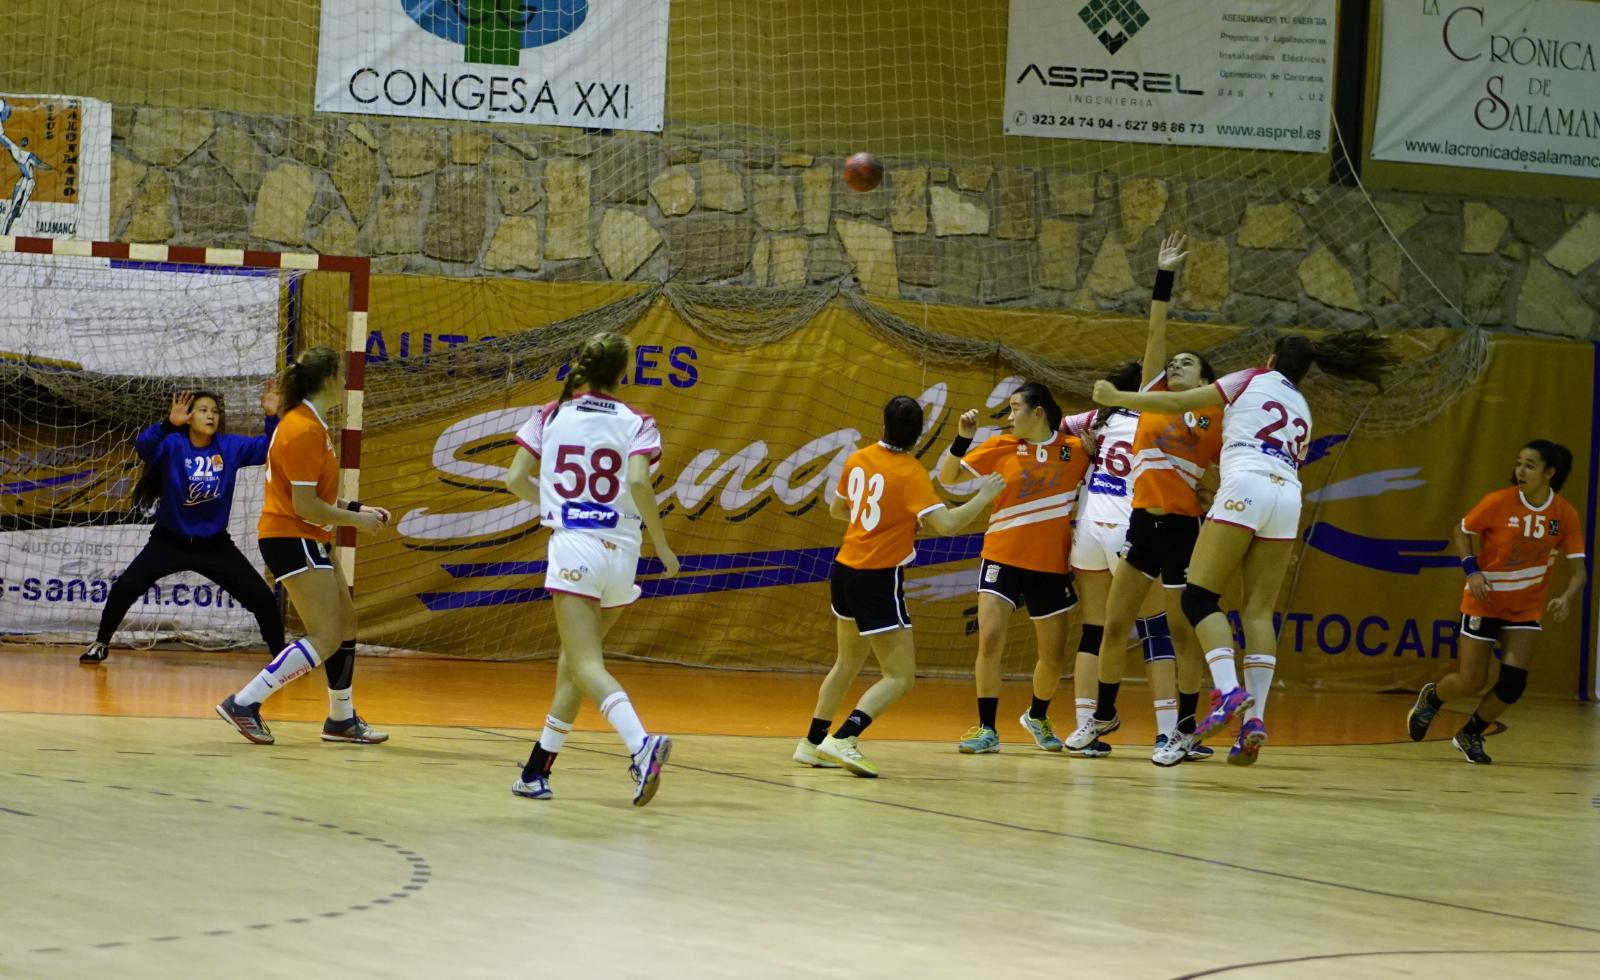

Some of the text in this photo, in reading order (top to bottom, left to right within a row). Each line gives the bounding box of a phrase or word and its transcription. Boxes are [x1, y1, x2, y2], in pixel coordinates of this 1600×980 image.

[1443, 6, 1597, 72] CRÓNICA
[1017, 64, 1204, 95] ASPREL
[1528, 77, 1552, 97] DE
[349, 68, 630, 119] CONGESA XXI
[1032, 114, 1055, 126] 923
[1059, 115, 1075, 126] 24
[1079, 117, 1094, 127] 74
[1098, 118, 1113, 128] 04
[1125, 119, 1148, 131] 627
[1190, 123, 1205, 134] 73
[1217, 123, 1321, 140] www.asprel.es
[1405, 140, 1600, 168] www.lacronicadesalamanc
[36, 220, 77, 235] SALAMANCA
[193, 455, 213, 476] 22
[1036, 445, 1048, 463] 6
[554, 444, 622, 503] 58
[847, 466, 885, 531] 93
[1224, 499, 1246, 512] GO
[566, 508, 615, 521] Sacyr
[1523, 514, 1546, 539] 15
[21, 542, 113, 556] AUTOCARES
